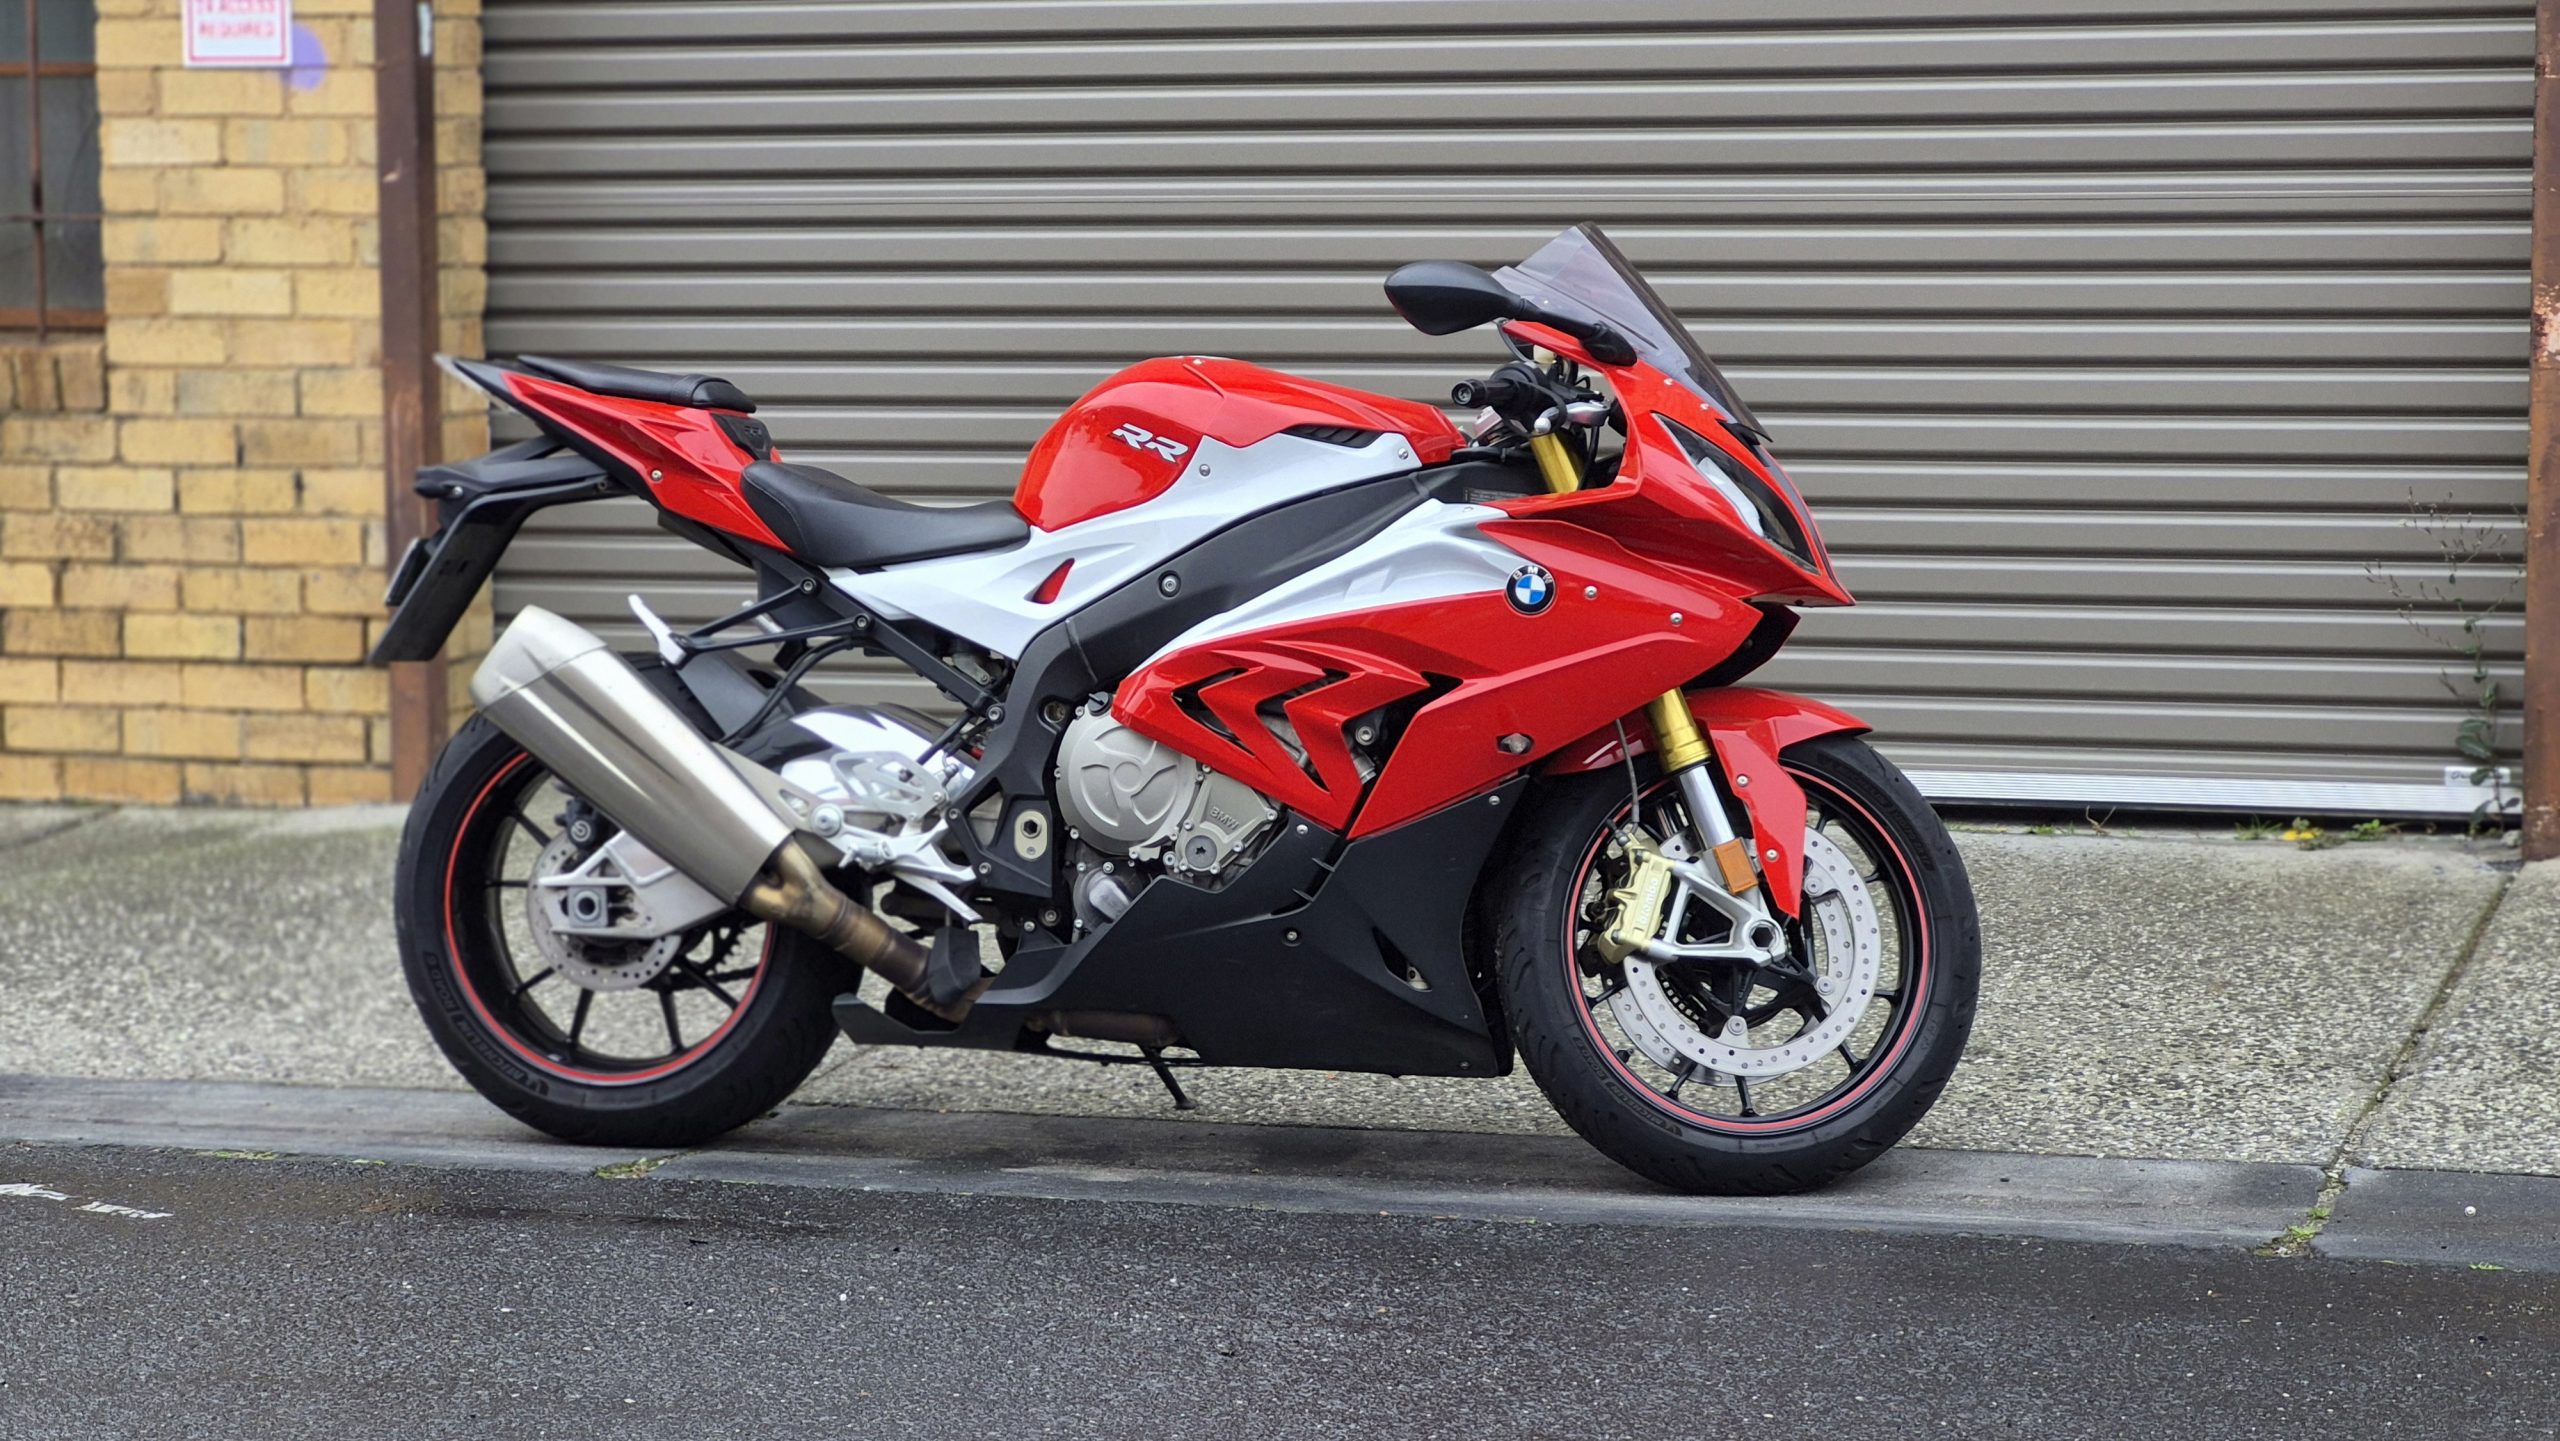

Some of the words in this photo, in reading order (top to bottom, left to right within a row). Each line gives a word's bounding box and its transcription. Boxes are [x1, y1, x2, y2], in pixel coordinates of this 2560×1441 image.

[1112, 423, 1189, 463] RR
[1512, 566, 1553, 584] BMW
[1210, 806, 1240, 831] BMW
[1635, 878, 1659, 926] brembo
[457, 1019, 526, 1081] MICHELIN
